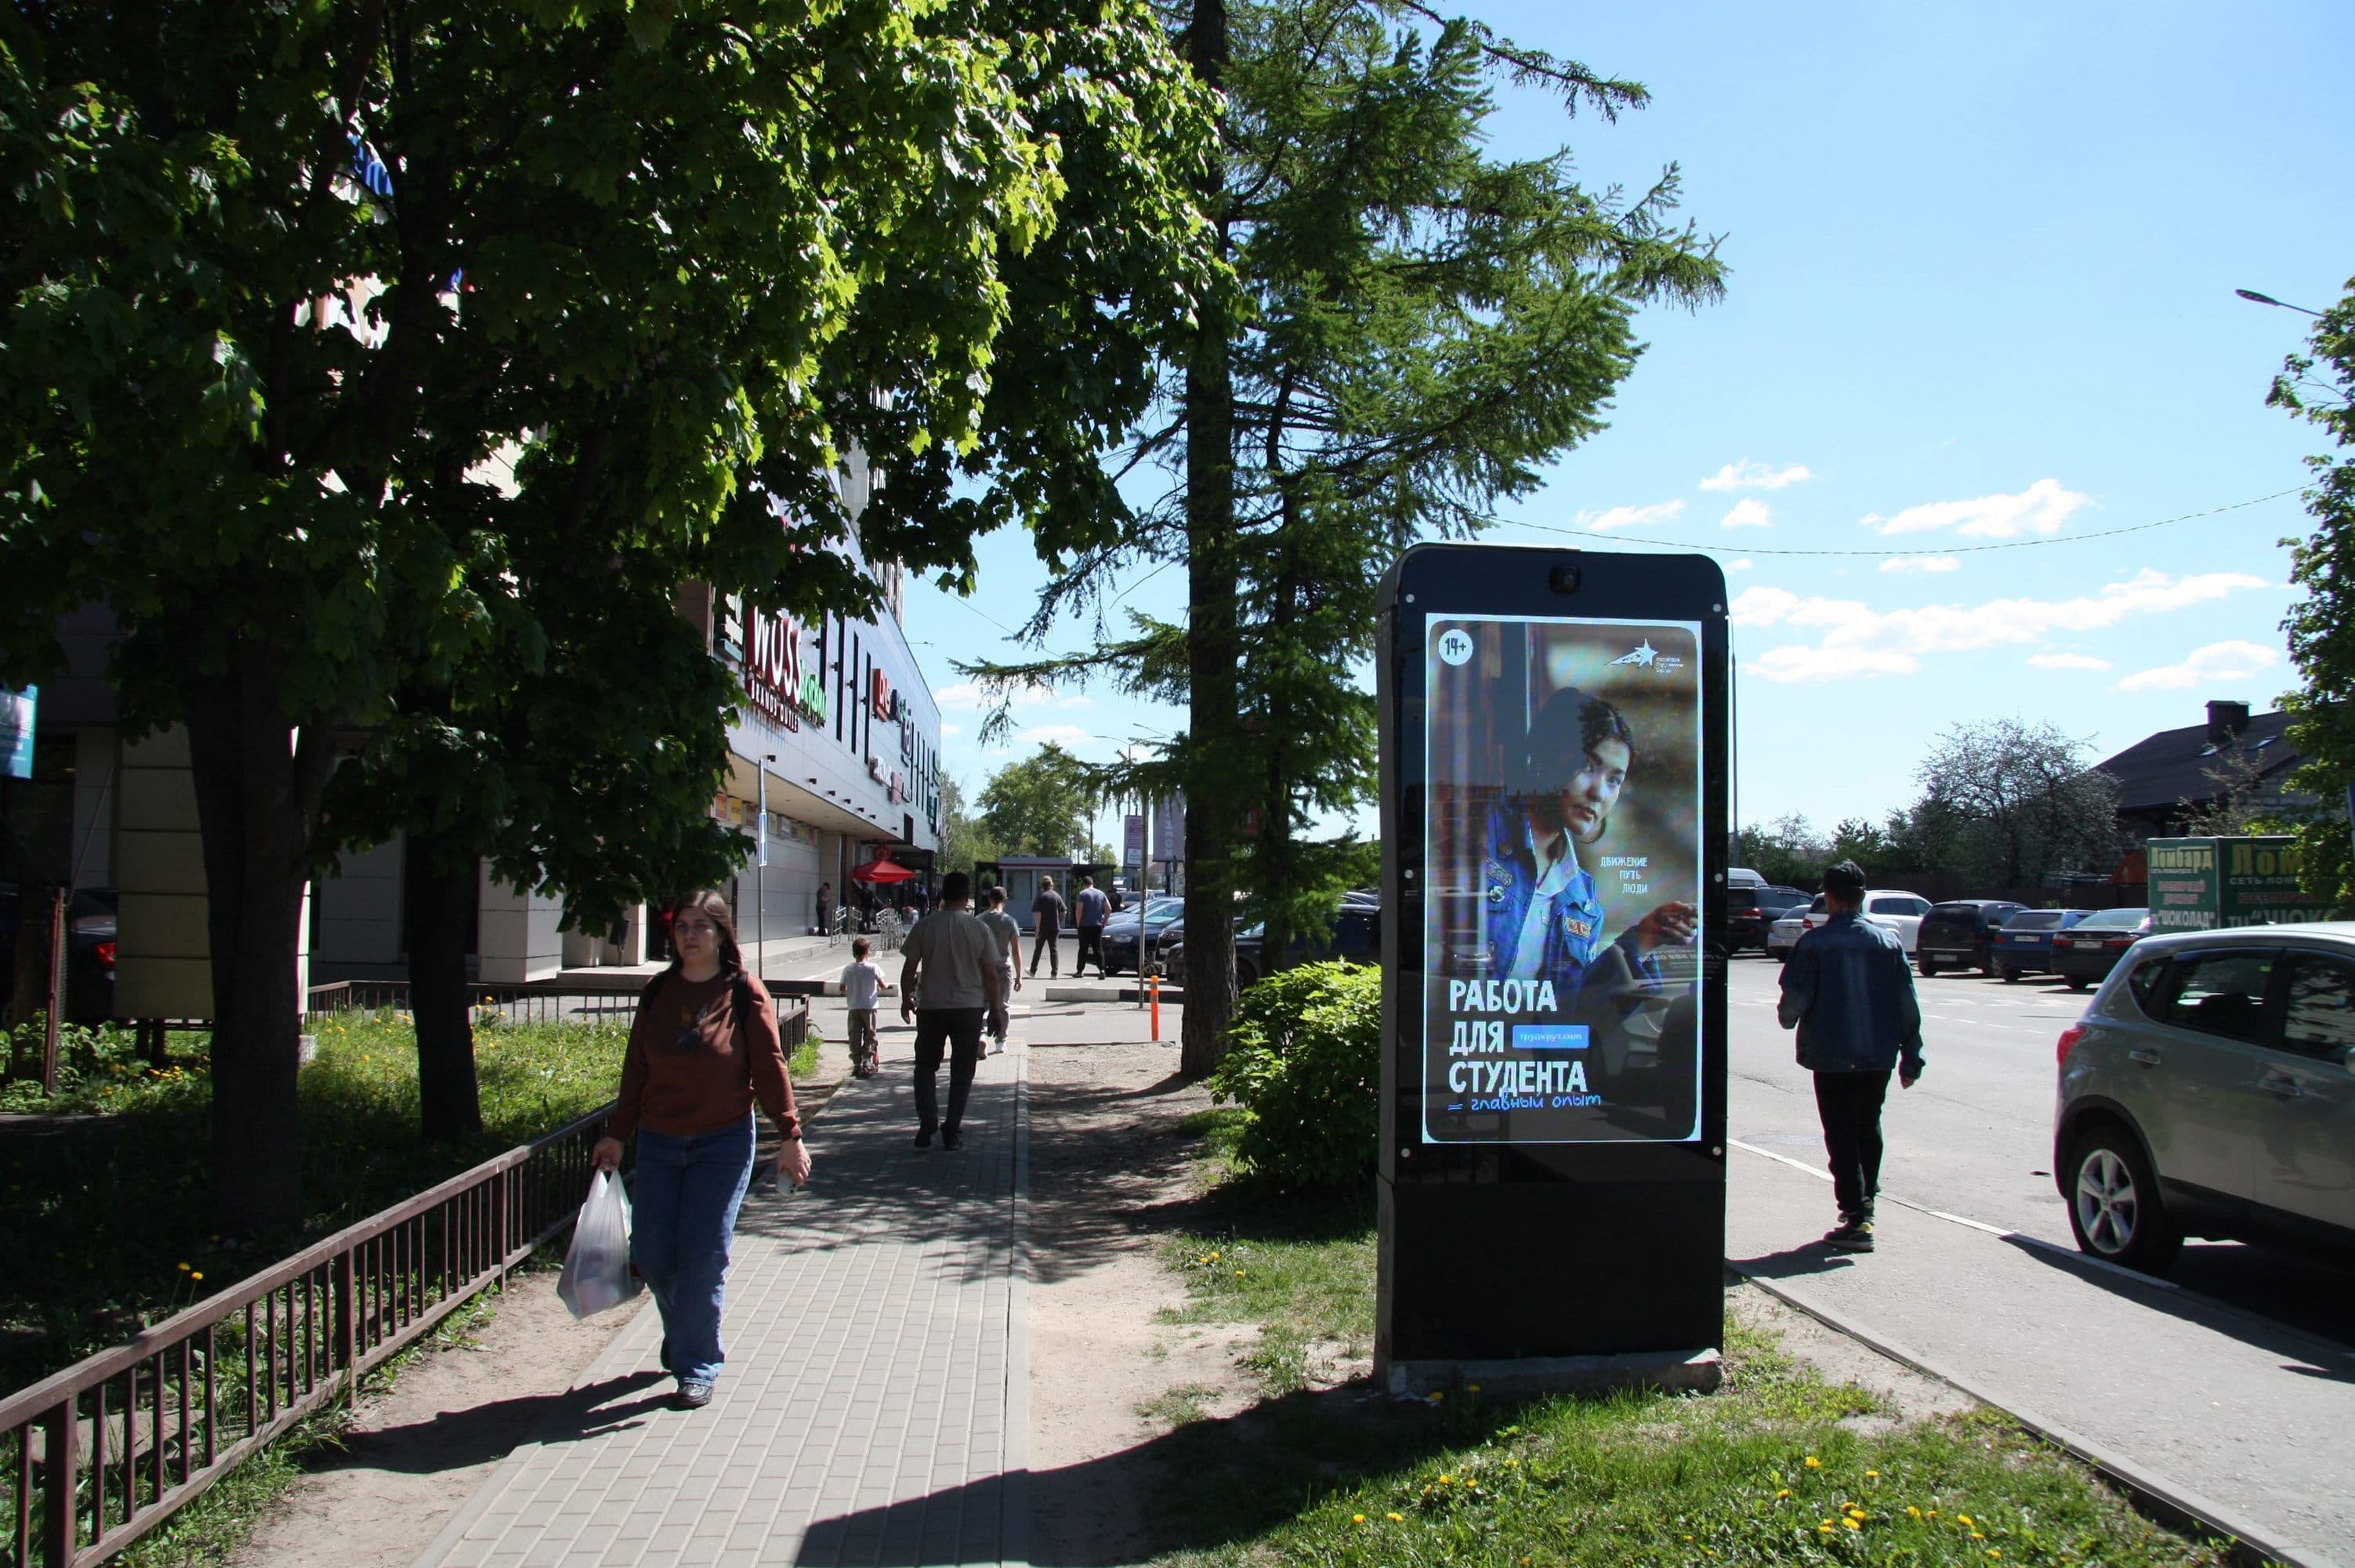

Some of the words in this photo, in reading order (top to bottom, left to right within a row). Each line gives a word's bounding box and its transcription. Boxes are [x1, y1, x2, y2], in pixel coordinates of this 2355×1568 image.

[1444, 637, 1466, 656] 14+
[1600, 856, 1647, 867] ДВИЖЕНИЕ
[1619, 871, 1642, 880] ПУТЬ
[1621, 884, 1648, 894] ЛЮДИ
[1450, 980, 1557, 1014] РАБОТА
[1449, 1021, 1505, 1056] ДЛЯ
[1449, 1061, 1588, 1097] СТУДЕНТА
[1471, 1089, 1544, 1110] главный
[1552, 1094, 1601, 1108] опыт
